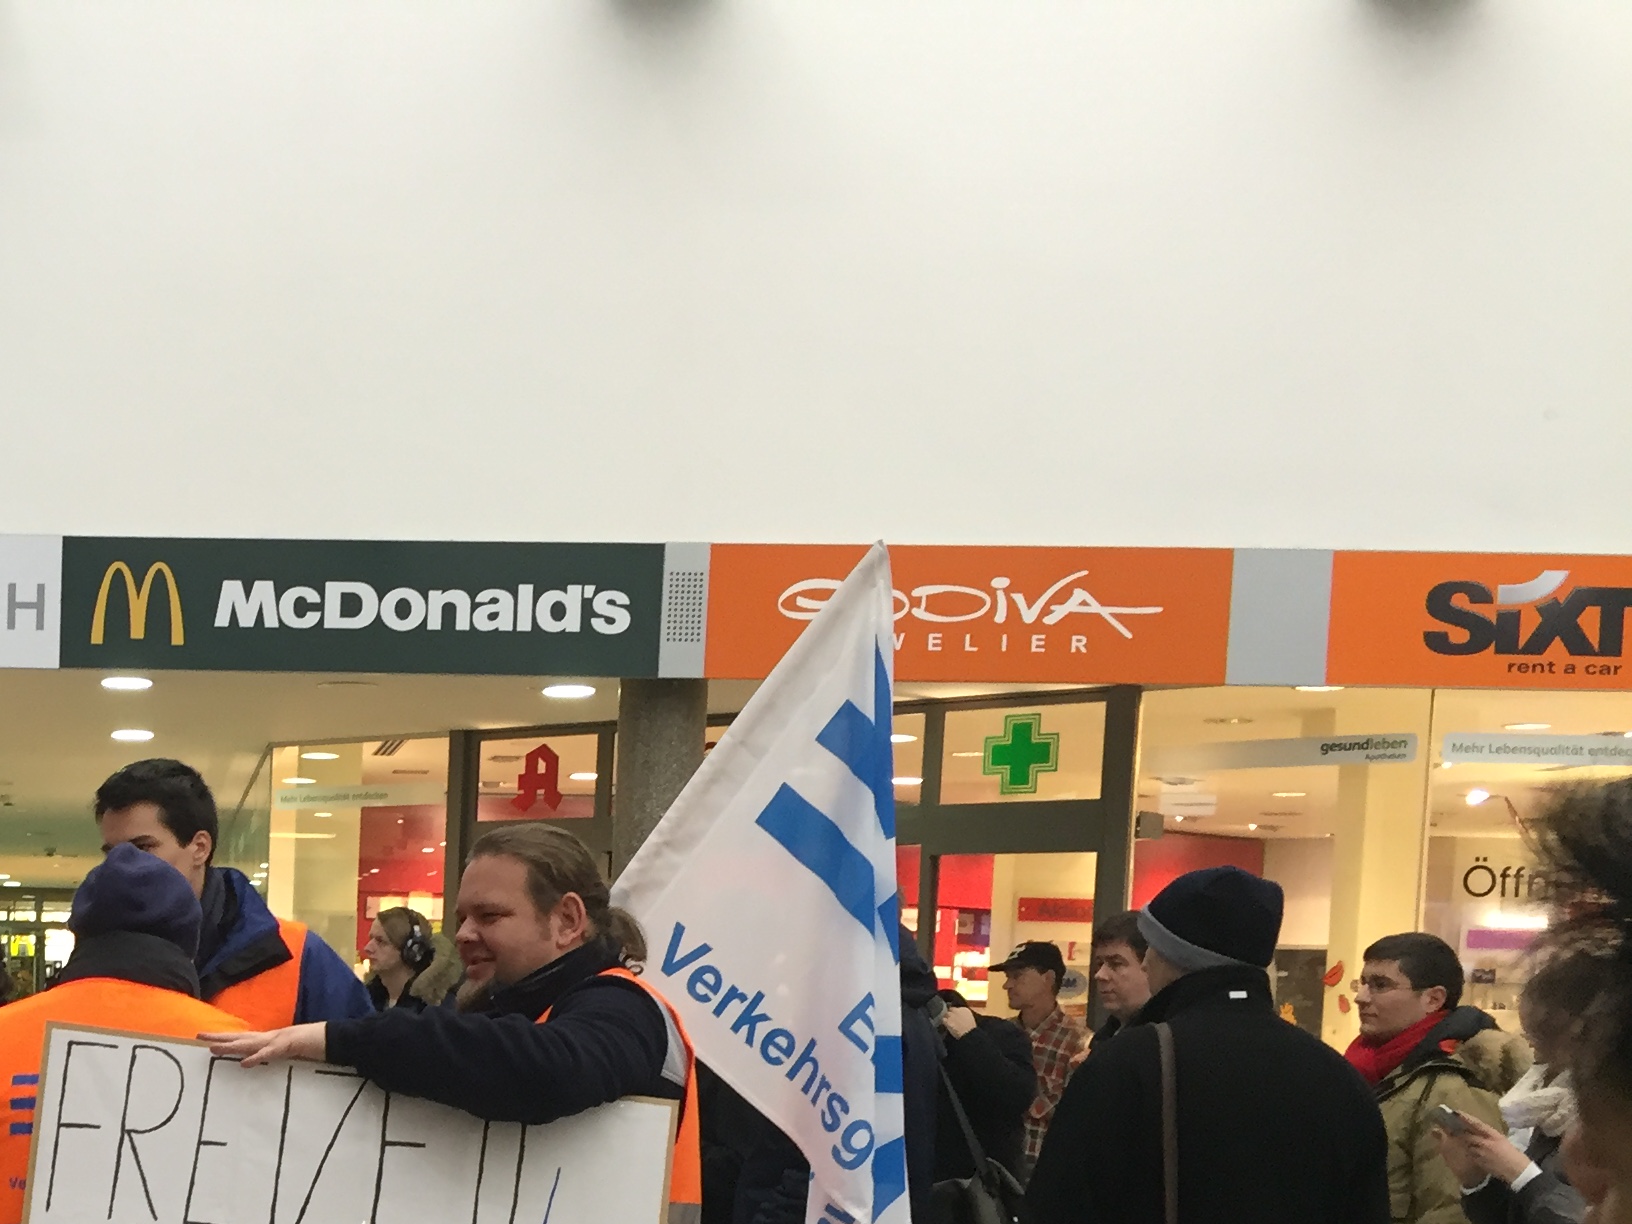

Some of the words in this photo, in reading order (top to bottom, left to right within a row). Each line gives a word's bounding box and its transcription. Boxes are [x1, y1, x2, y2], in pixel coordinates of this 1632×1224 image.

[214, 579, 632, 635] McDonald's
[1506, 660, 1556, 675] rent
[1563, 662, 1576, 675] a
[1584, 663, 1623, 676] car
[1320, 737, 1409, 756] gesundleben
[1451, 742, 1486, 755] Mehr
